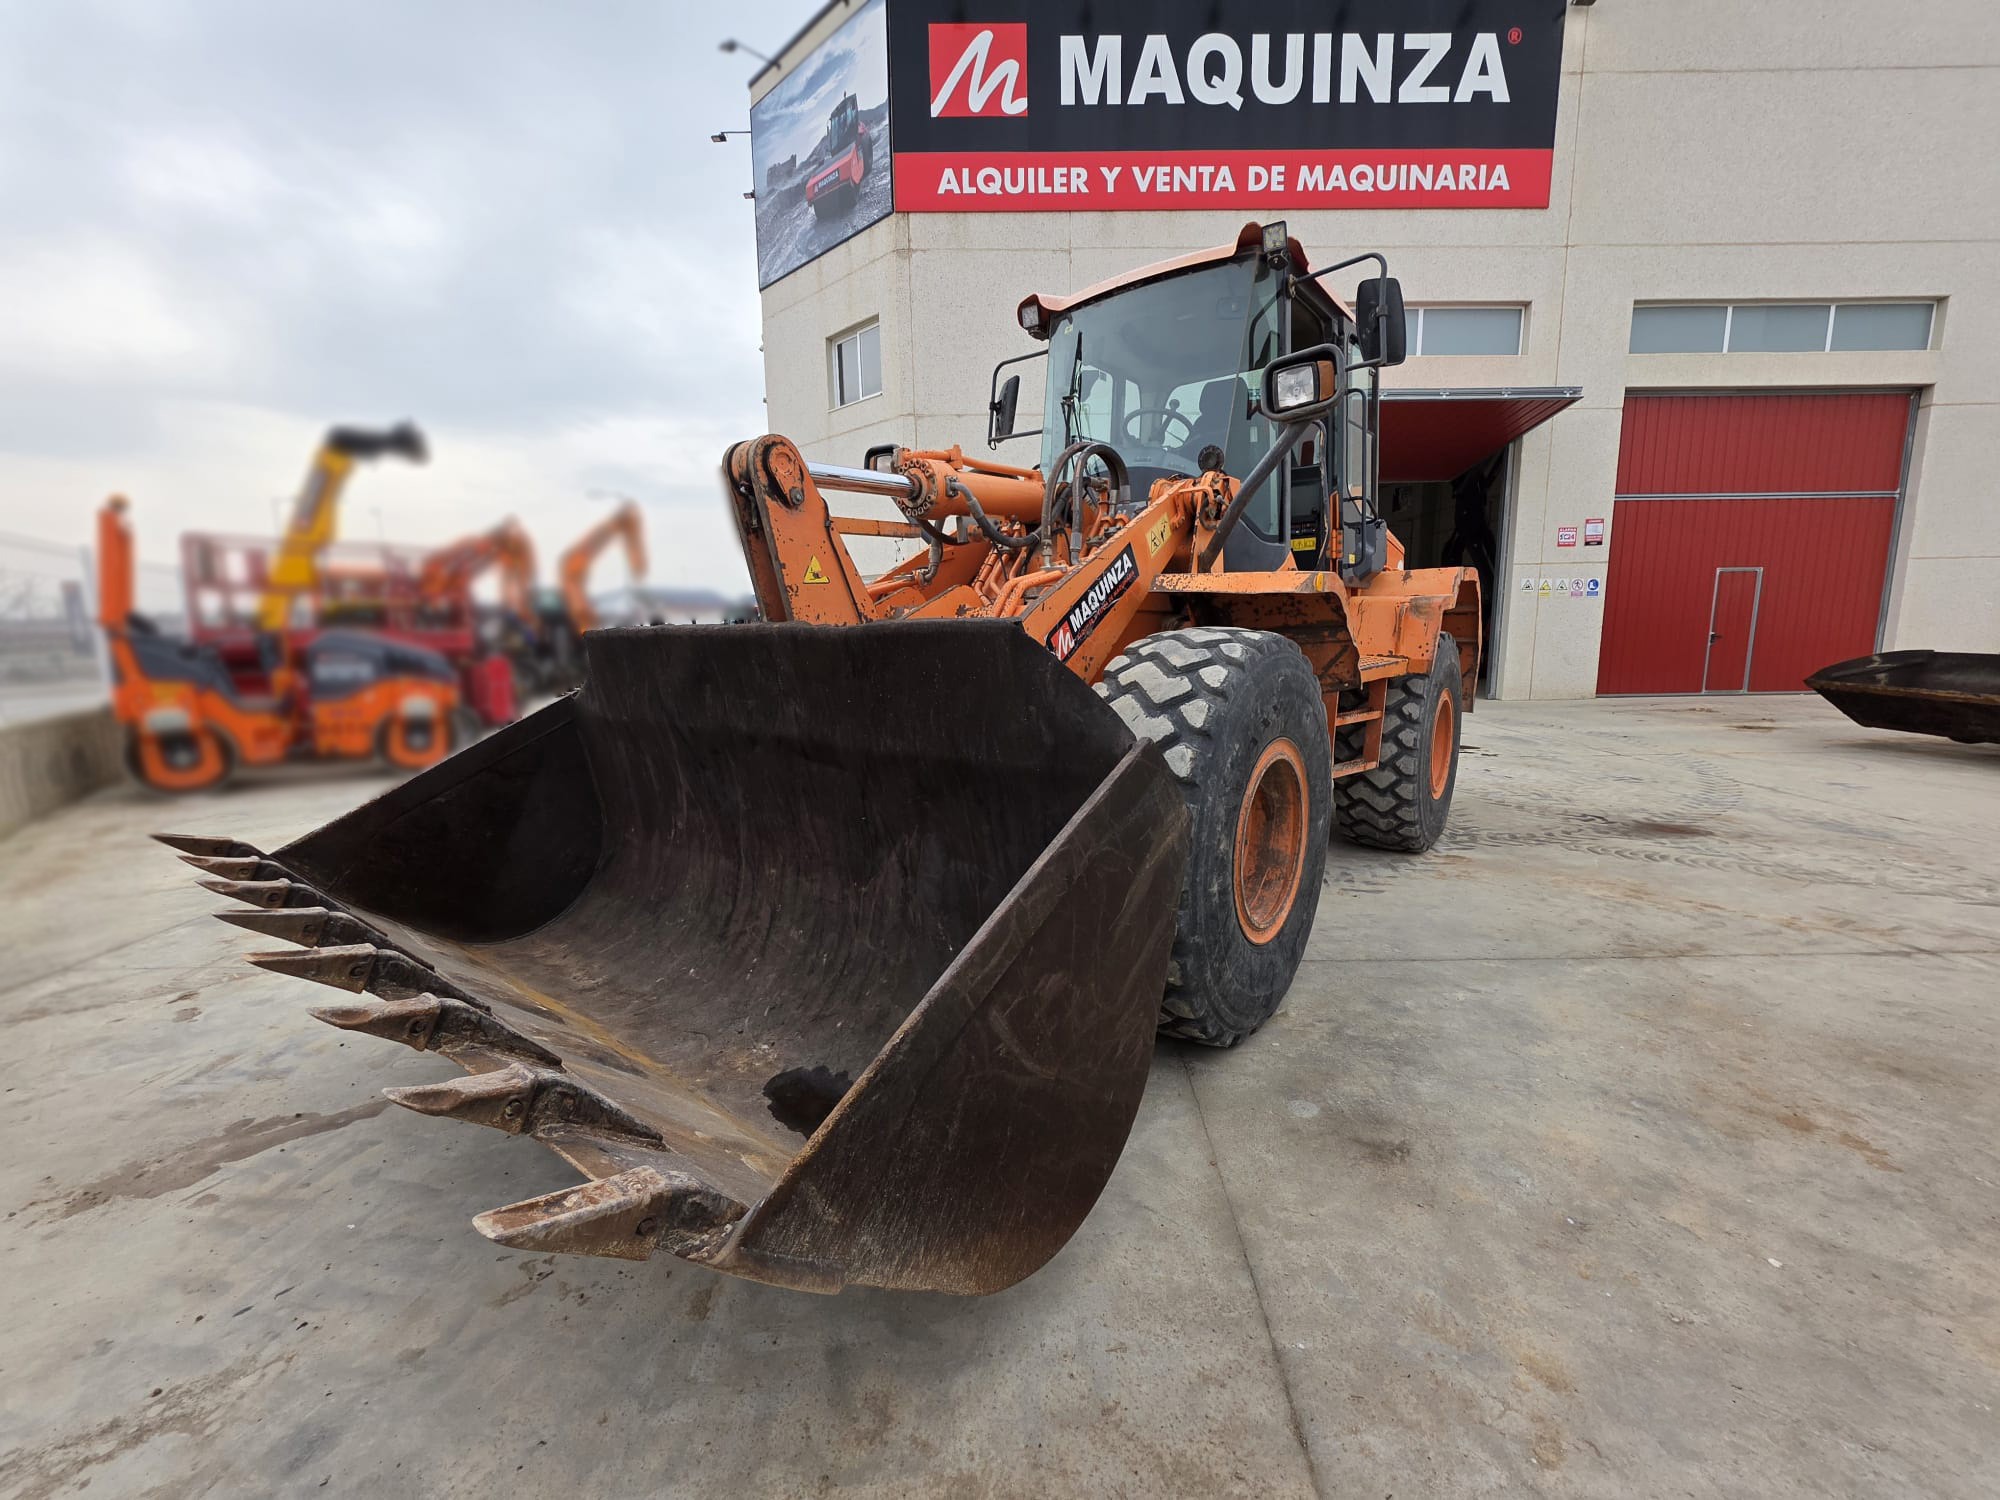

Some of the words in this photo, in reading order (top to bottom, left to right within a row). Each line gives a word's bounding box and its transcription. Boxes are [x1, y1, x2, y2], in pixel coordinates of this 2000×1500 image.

[1060, 33, 1510, 111] MAQUINZA
[937, 167, 1089, 195] ALQUILER
[1100, 166, 1122, 193] Y
[1132, 166, 1236, 193] VENTA
[1248, 165, 1285, 192] DE
[1297, 164, 1510, 192] MAQUINARIA
[1070, 553, 1132, 633] MAQUINZA
